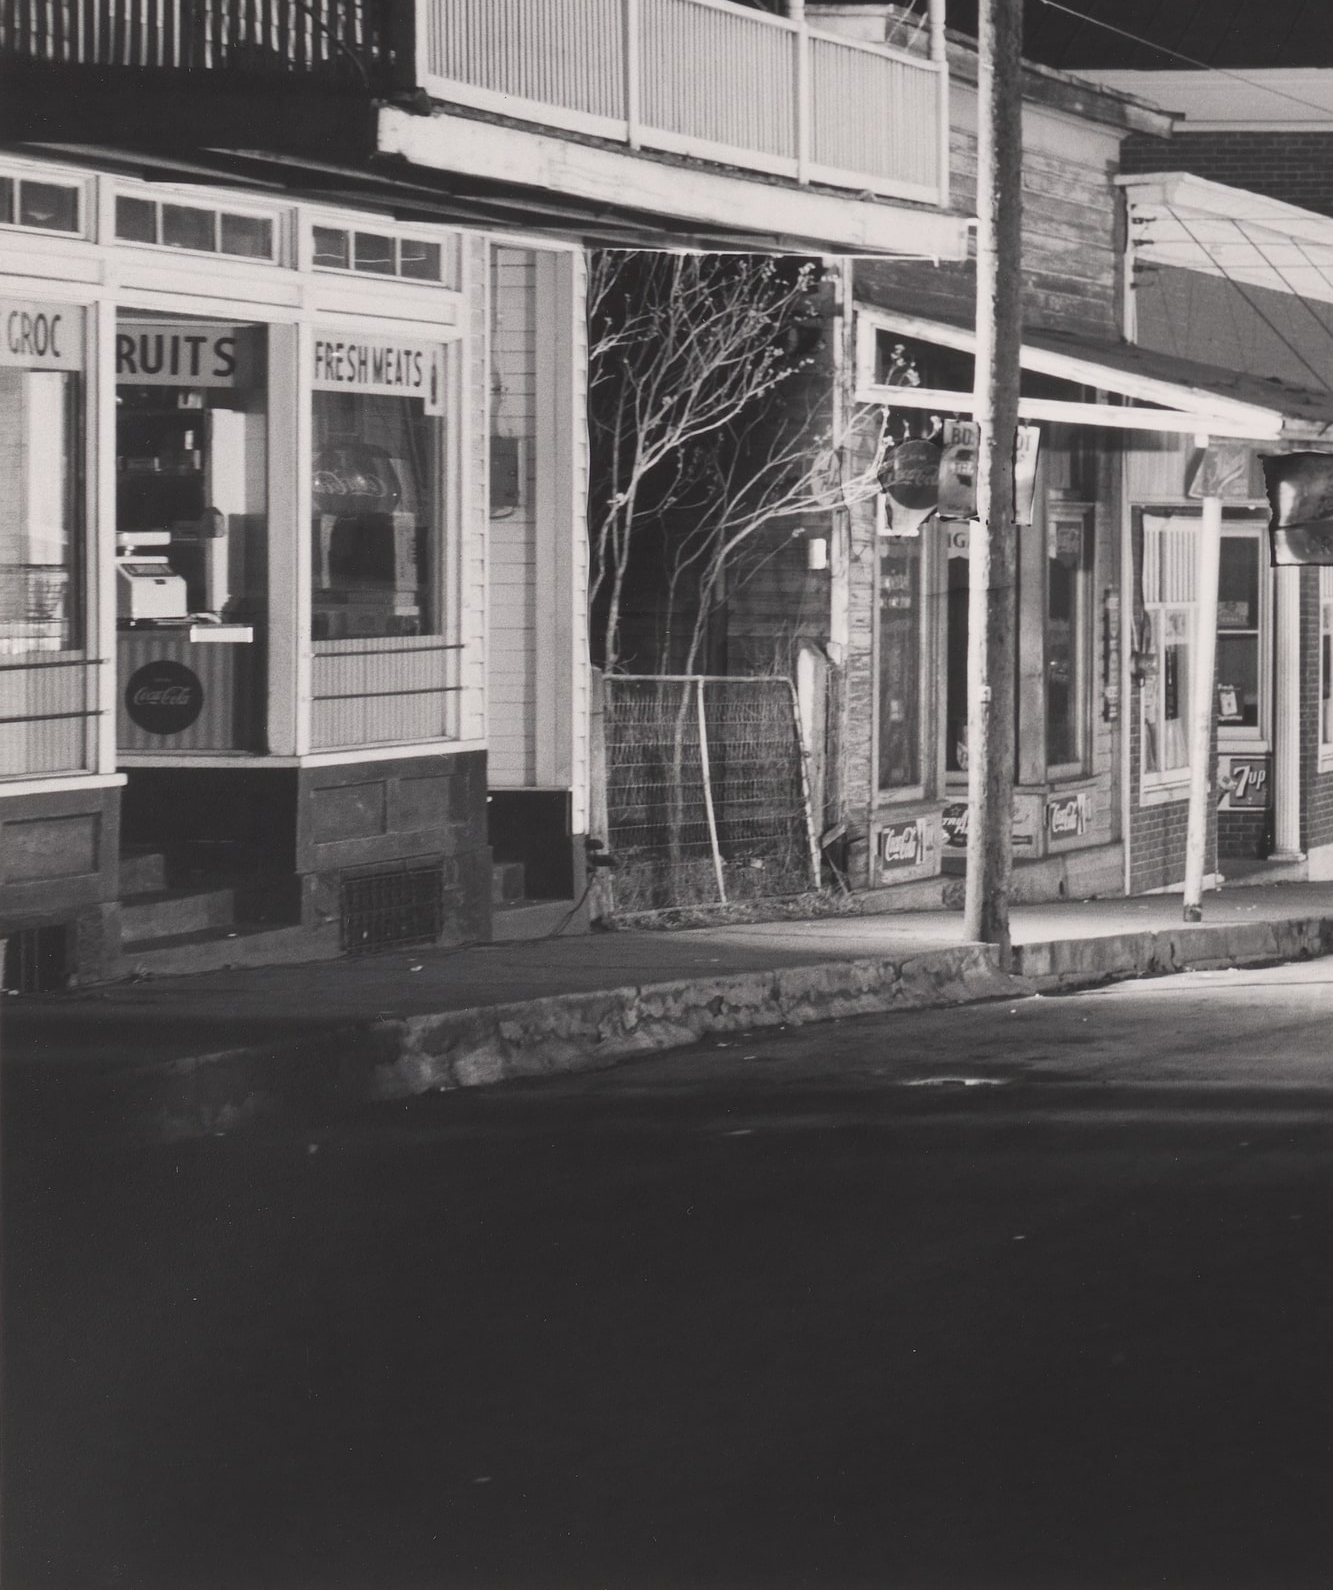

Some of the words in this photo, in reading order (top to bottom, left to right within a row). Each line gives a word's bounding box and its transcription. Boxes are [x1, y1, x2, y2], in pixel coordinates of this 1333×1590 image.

[7, 311, 62, 358] GROC
[116, 334, 237, 377] RUITS
[315, 340, 368, 383] FRESH
[373, 347, 423, 388] MEATS
